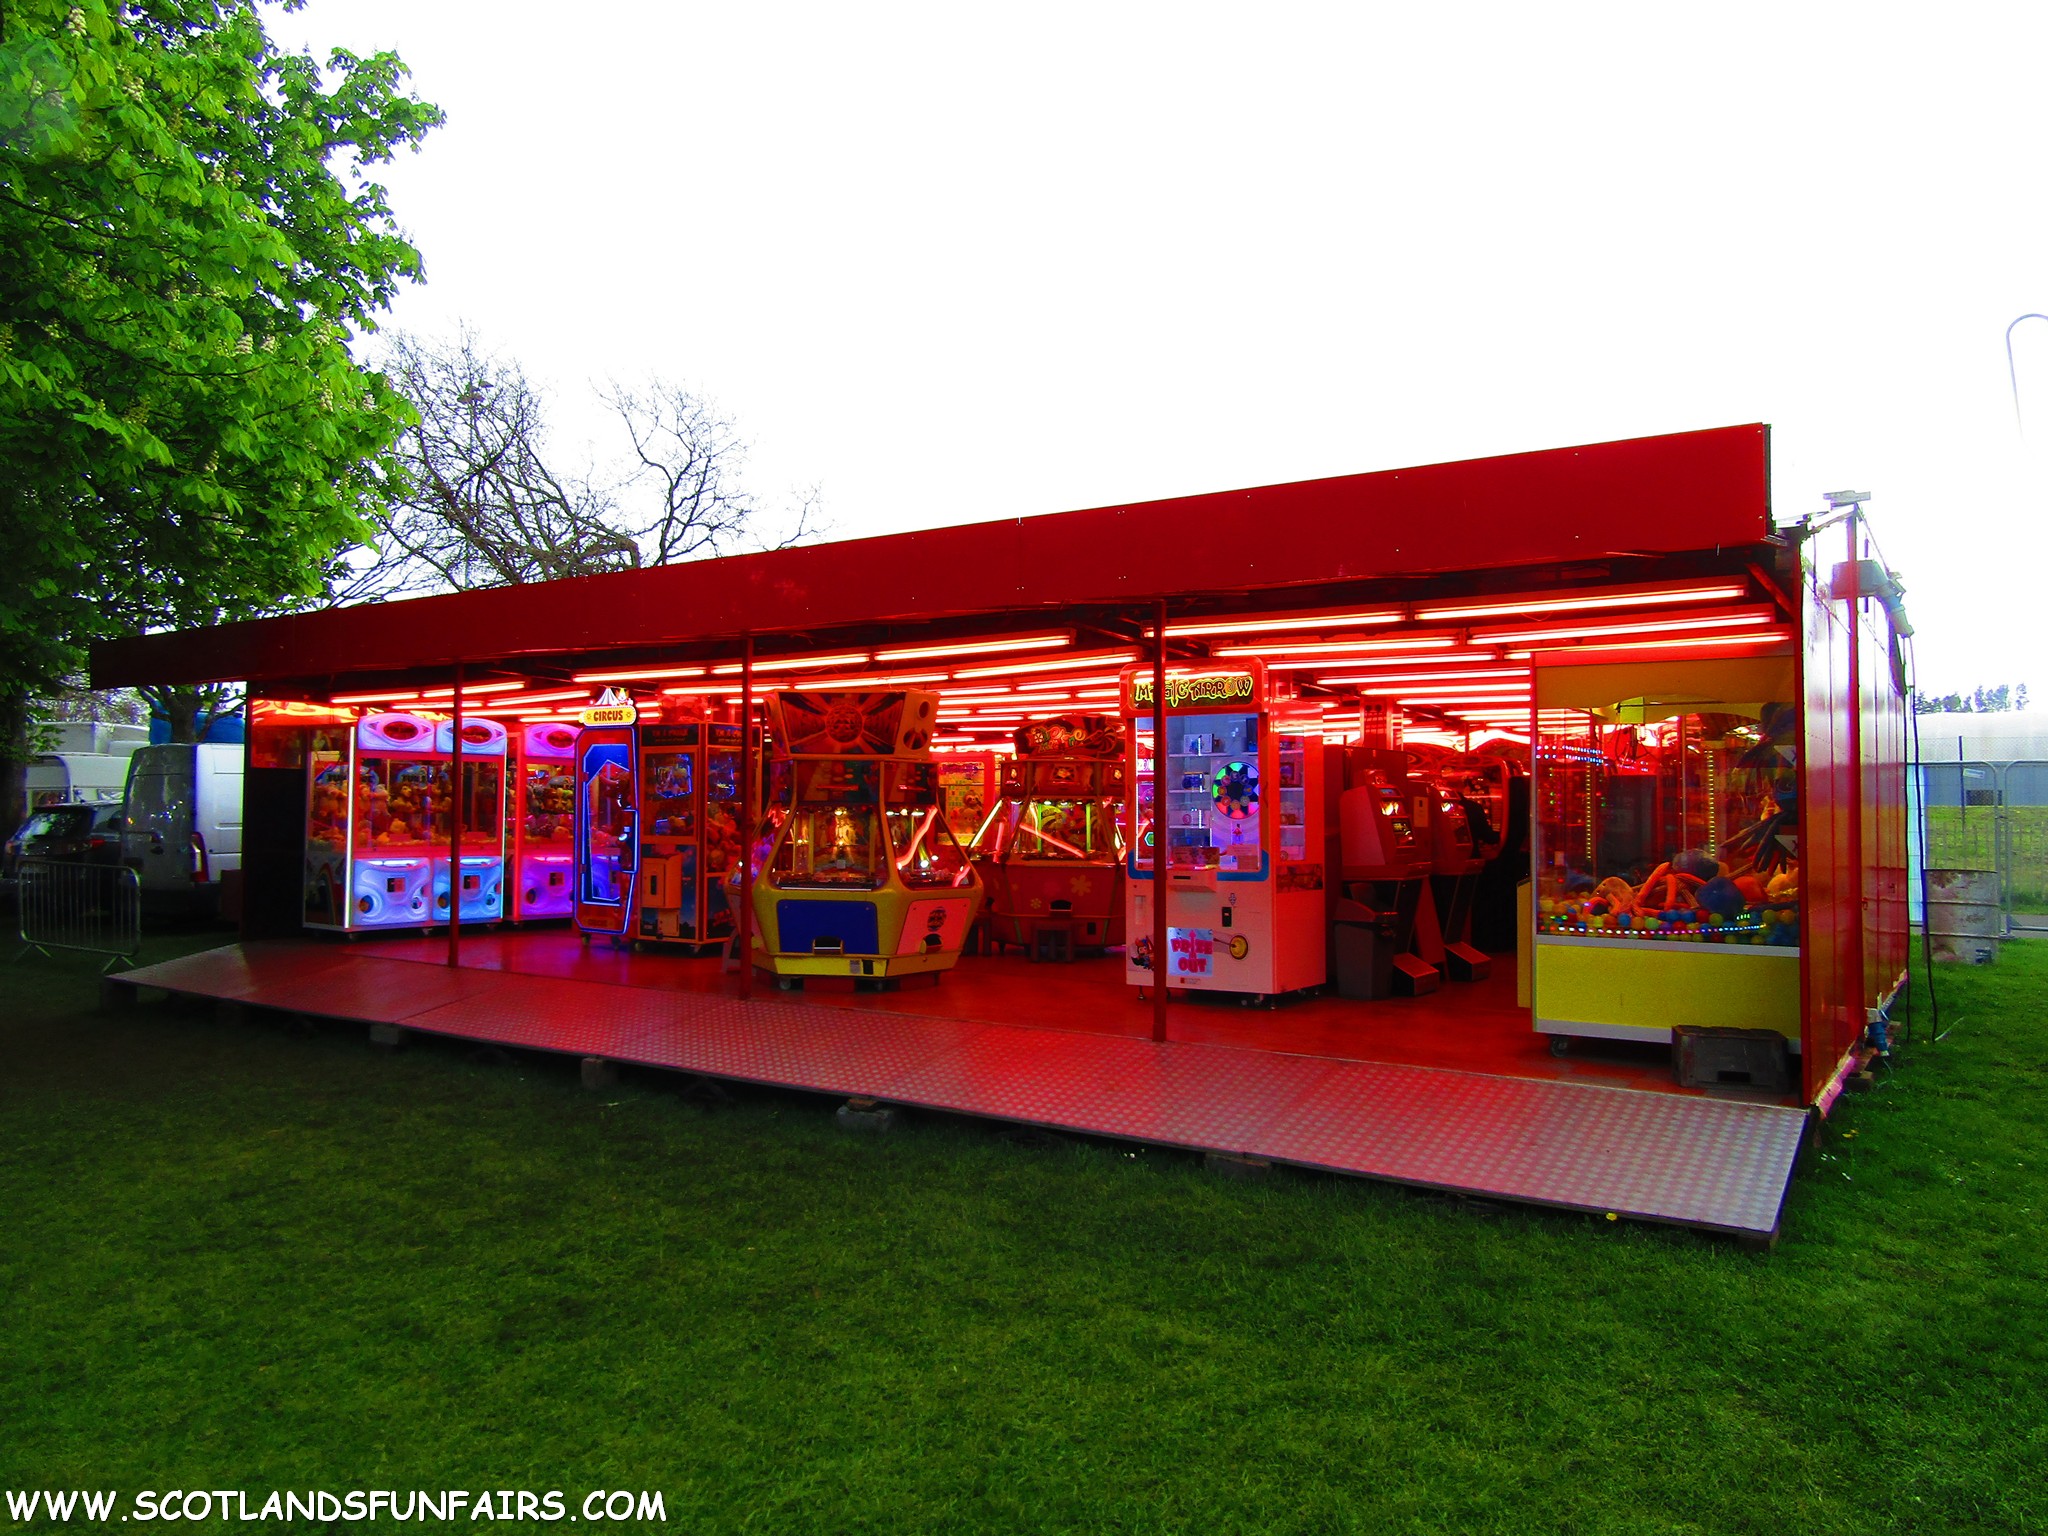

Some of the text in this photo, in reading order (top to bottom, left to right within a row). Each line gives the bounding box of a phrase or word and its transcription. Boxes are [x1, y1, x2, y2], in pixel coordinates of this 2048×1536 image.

[1189, 676, 1253, 701] ARROW
[593, 709, 624, 722] CIRCUS
[1170, 936, 1213, 956] PRIZE
[1177, 956, 1207, 973] OUT
